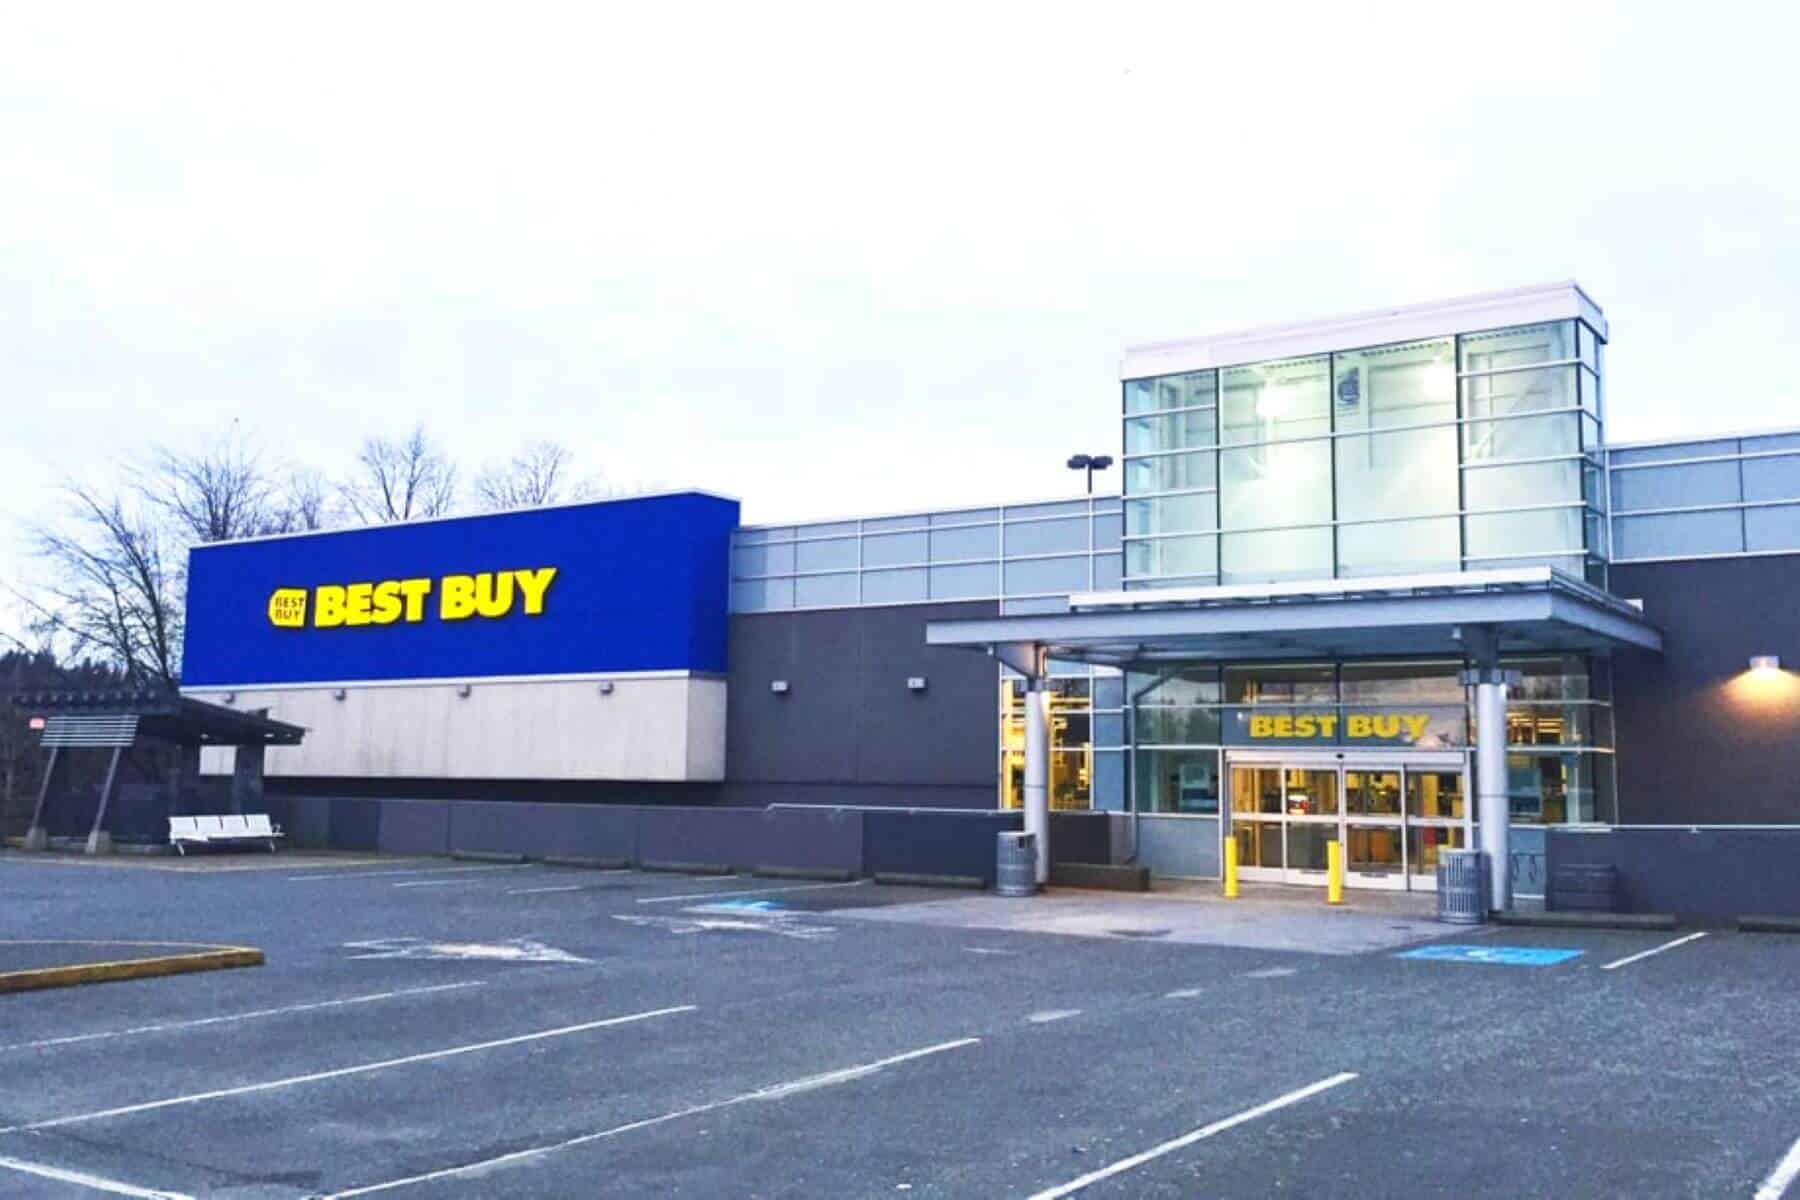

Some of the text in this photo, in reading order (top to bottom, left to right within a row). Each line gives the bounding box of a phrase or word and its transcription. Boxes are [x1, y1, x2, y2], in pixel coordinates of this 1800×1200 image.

[275, 597, 305, 608] BEST
[314, 567, 557, 628] BEST BUY
[1250, 714, 1429, 740] BEST BUY
